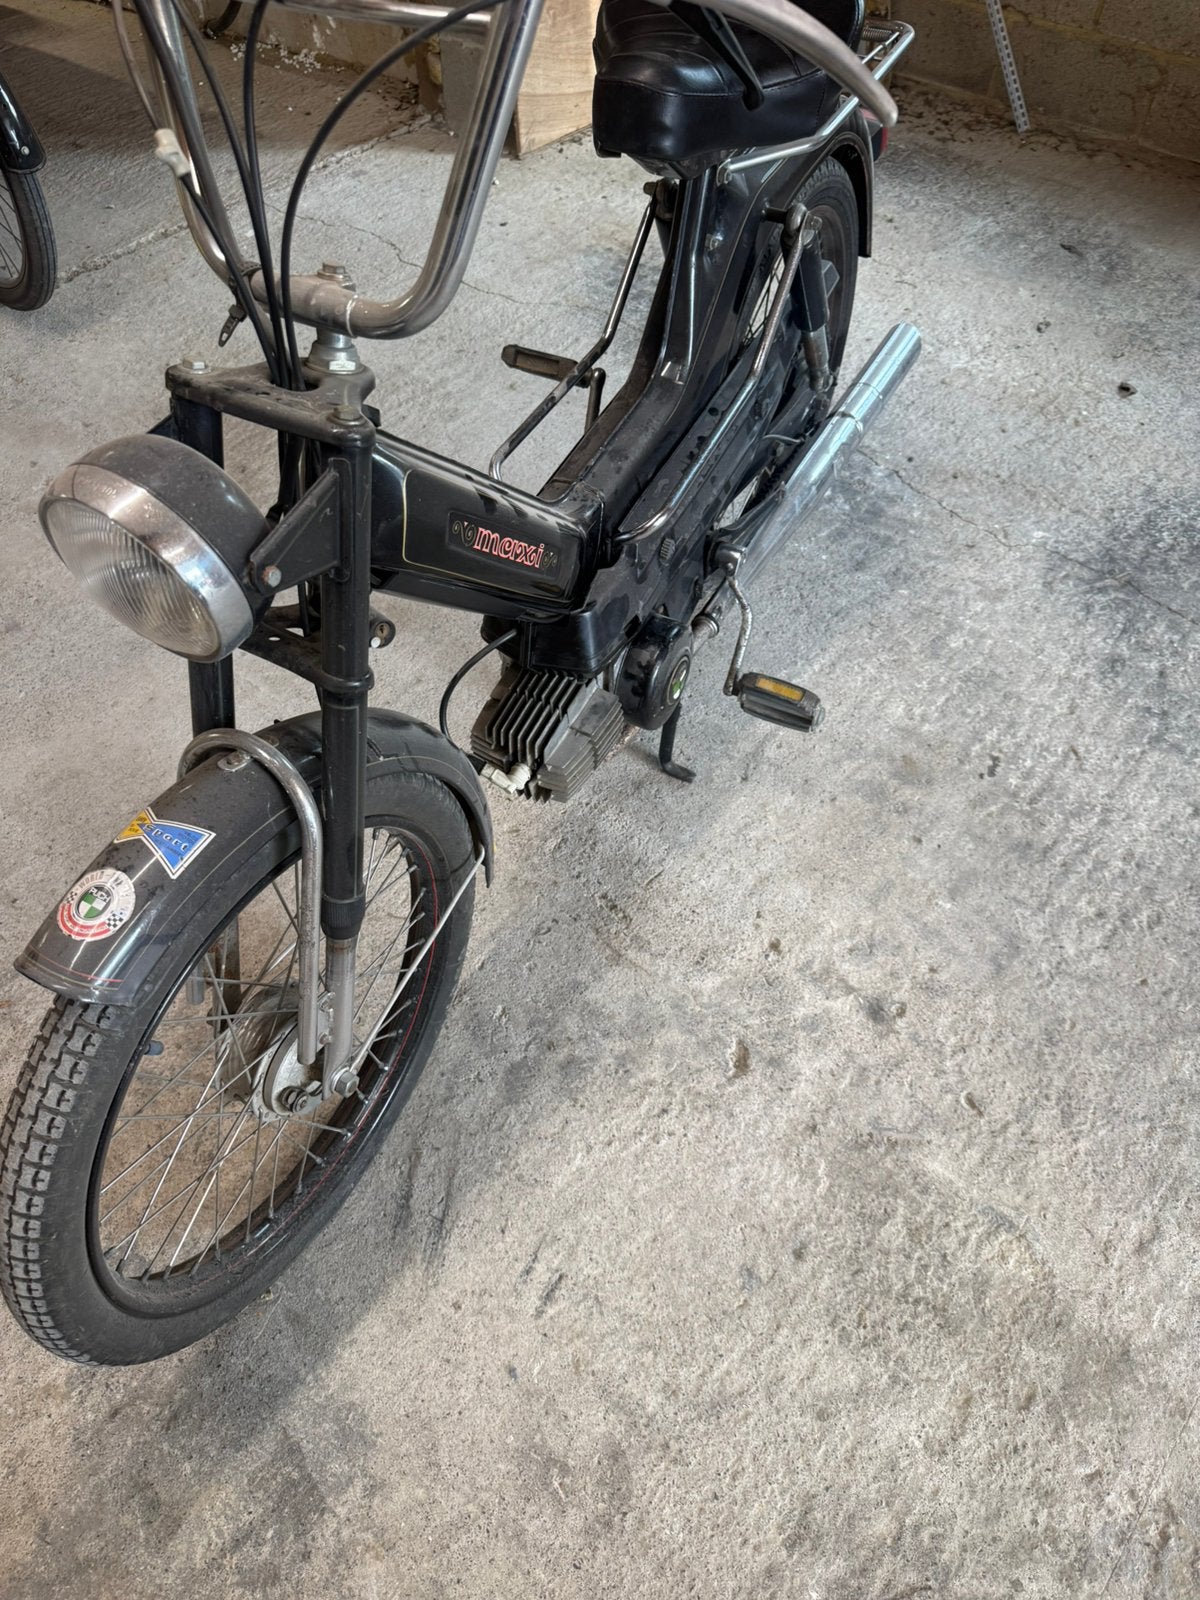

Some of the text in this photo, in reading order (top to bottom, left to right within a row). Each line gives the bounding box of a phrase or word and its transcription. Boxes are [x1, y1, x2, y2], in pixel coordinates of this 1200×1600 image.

[473, 526, 545, 568] maxi
[143, 823, 190, 852] Sport
[88, 886, 111, 903] PUCH
